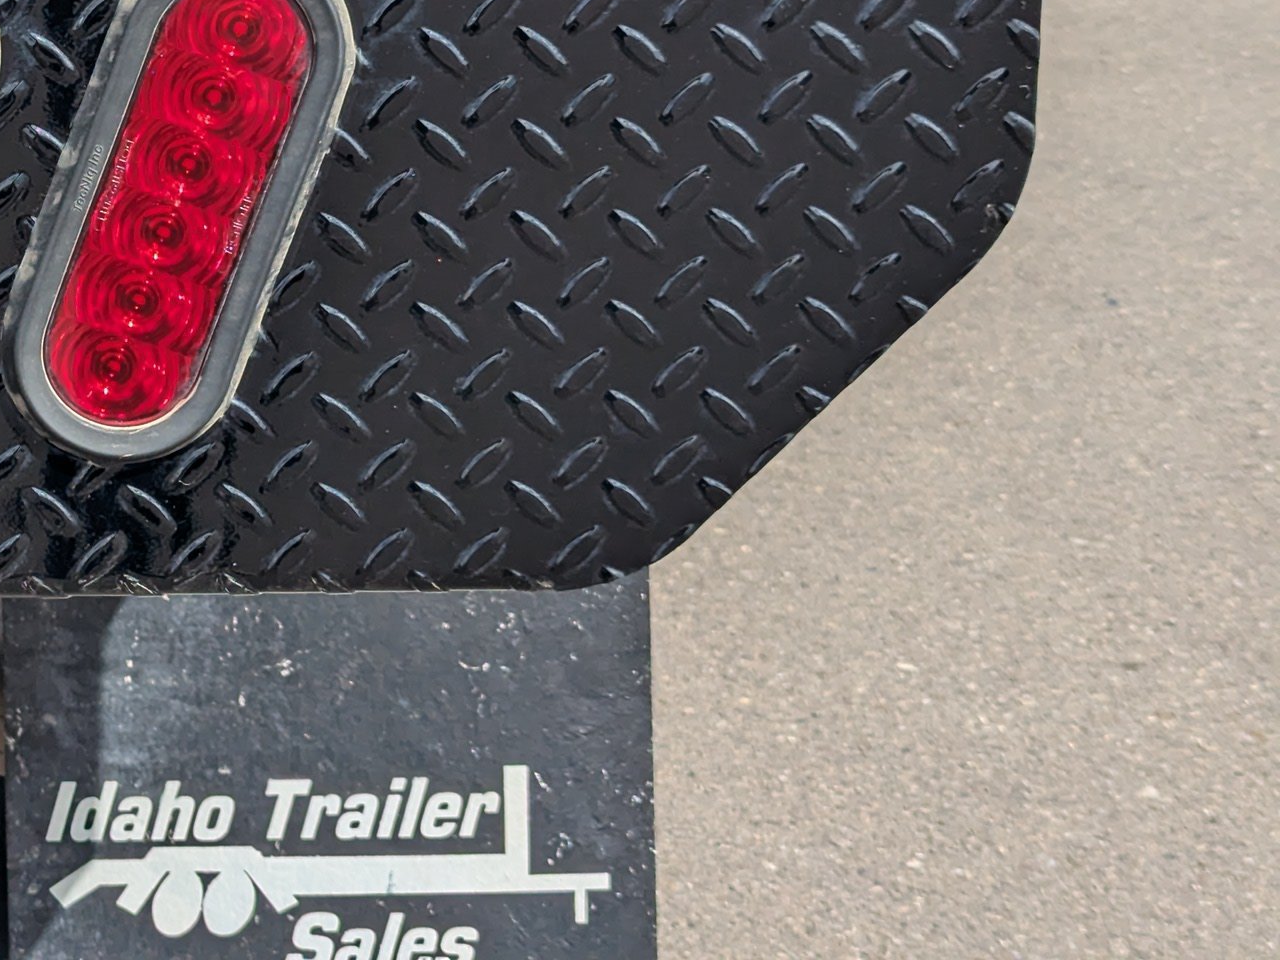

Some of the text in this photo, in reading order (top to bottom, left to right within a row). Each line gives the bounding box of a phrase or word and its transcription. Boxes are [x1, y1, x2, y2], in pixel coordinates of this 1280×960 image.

[46, 776, 501, 842] Idaho Trailer
[285, 911, 480, 960] Sales
